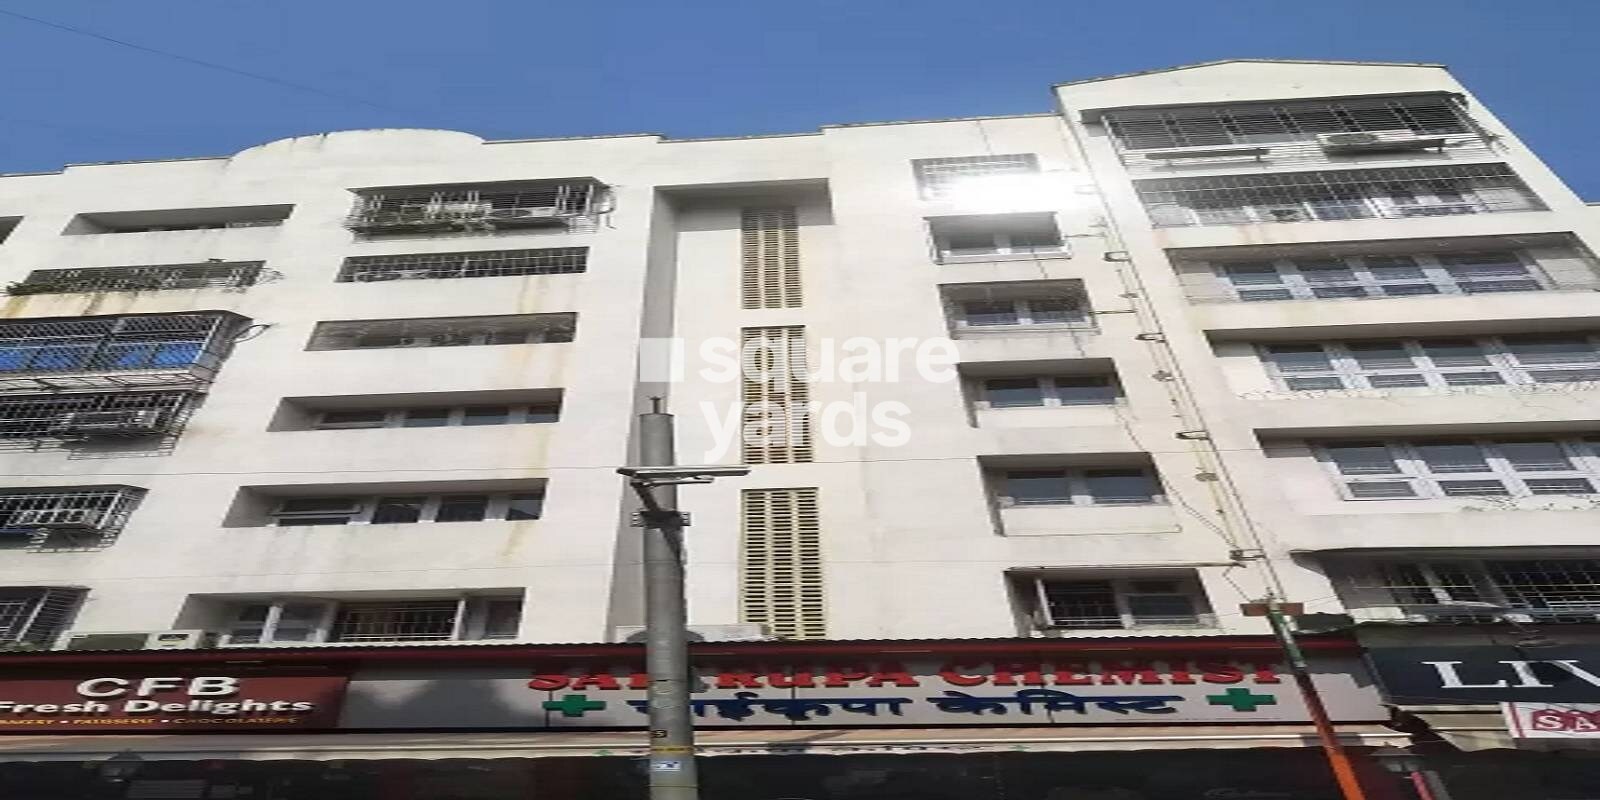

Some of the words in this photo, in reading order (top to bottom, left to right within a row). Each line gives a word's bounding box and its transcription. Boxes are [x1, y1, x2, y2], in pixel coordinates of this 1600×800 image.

[938, 657, 1282, 686] CHEMIST
[77, 677, 241, 698] CFB
[122, 698, 313, 715] Delights
[926, 689, 1186, 716] केमिस्ट
